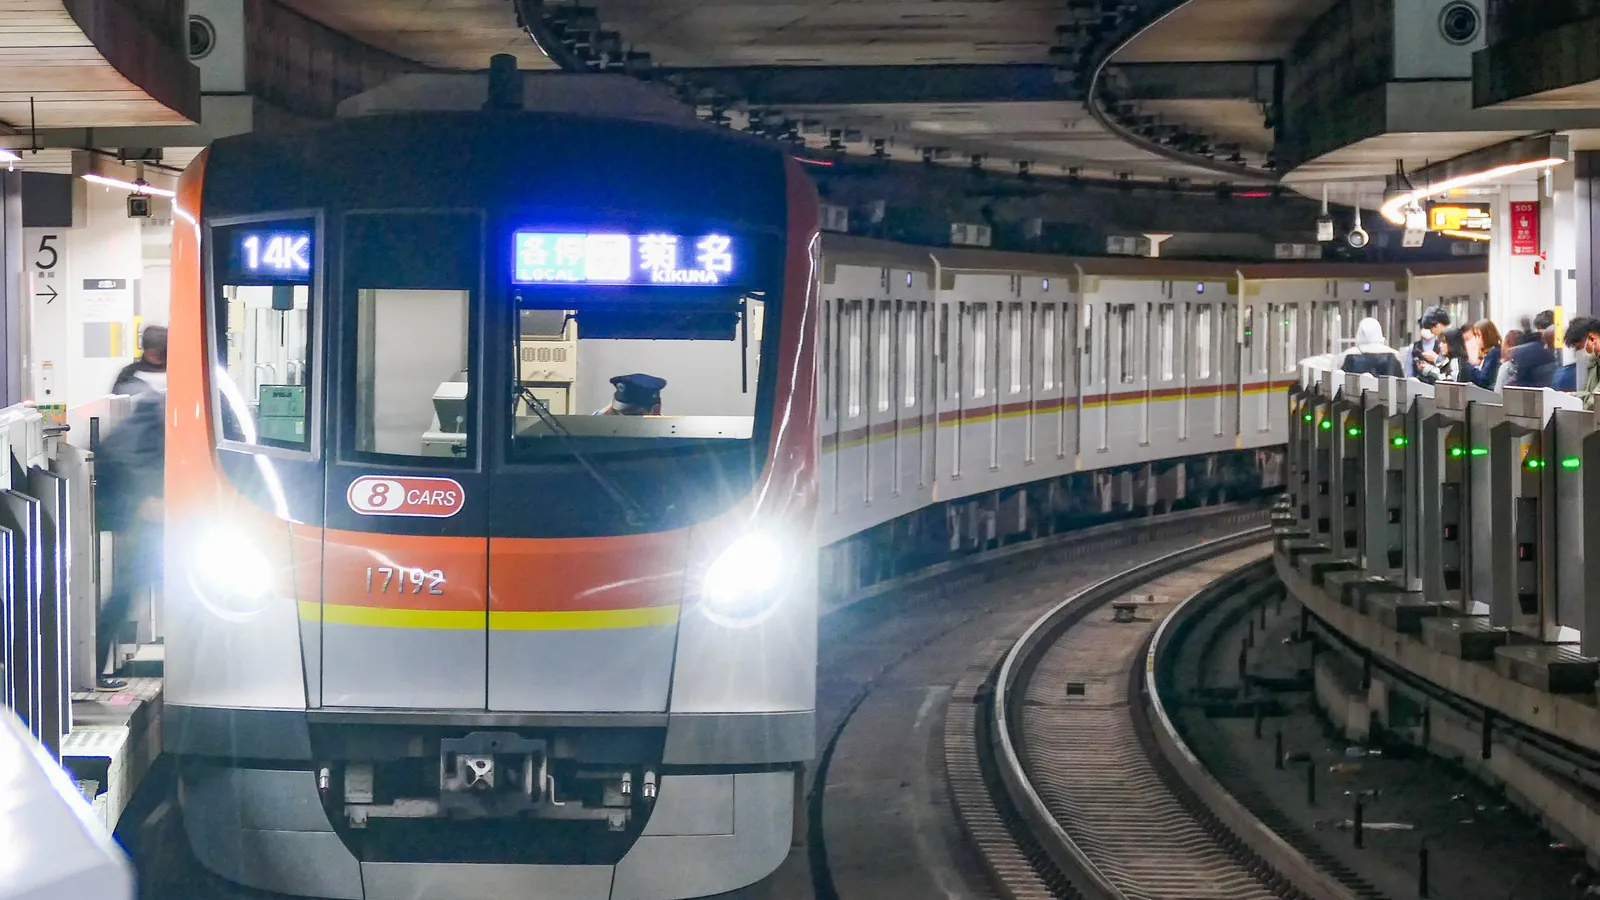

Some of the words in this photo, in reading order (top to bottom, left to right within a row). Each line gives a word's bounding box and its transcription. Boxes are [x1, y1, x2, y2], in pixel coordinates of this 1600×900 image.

[35, 235, 58, 270] 5
[244, 236, 309, 268] 14K
[521, 268, 579, 281] LOCAL
[652, 269, 718, 282] KIKUNA
[367, 483, 390, 507] 8
[407, 489, 456, 506] CARS
[366, 567, 444, 595] 17192
